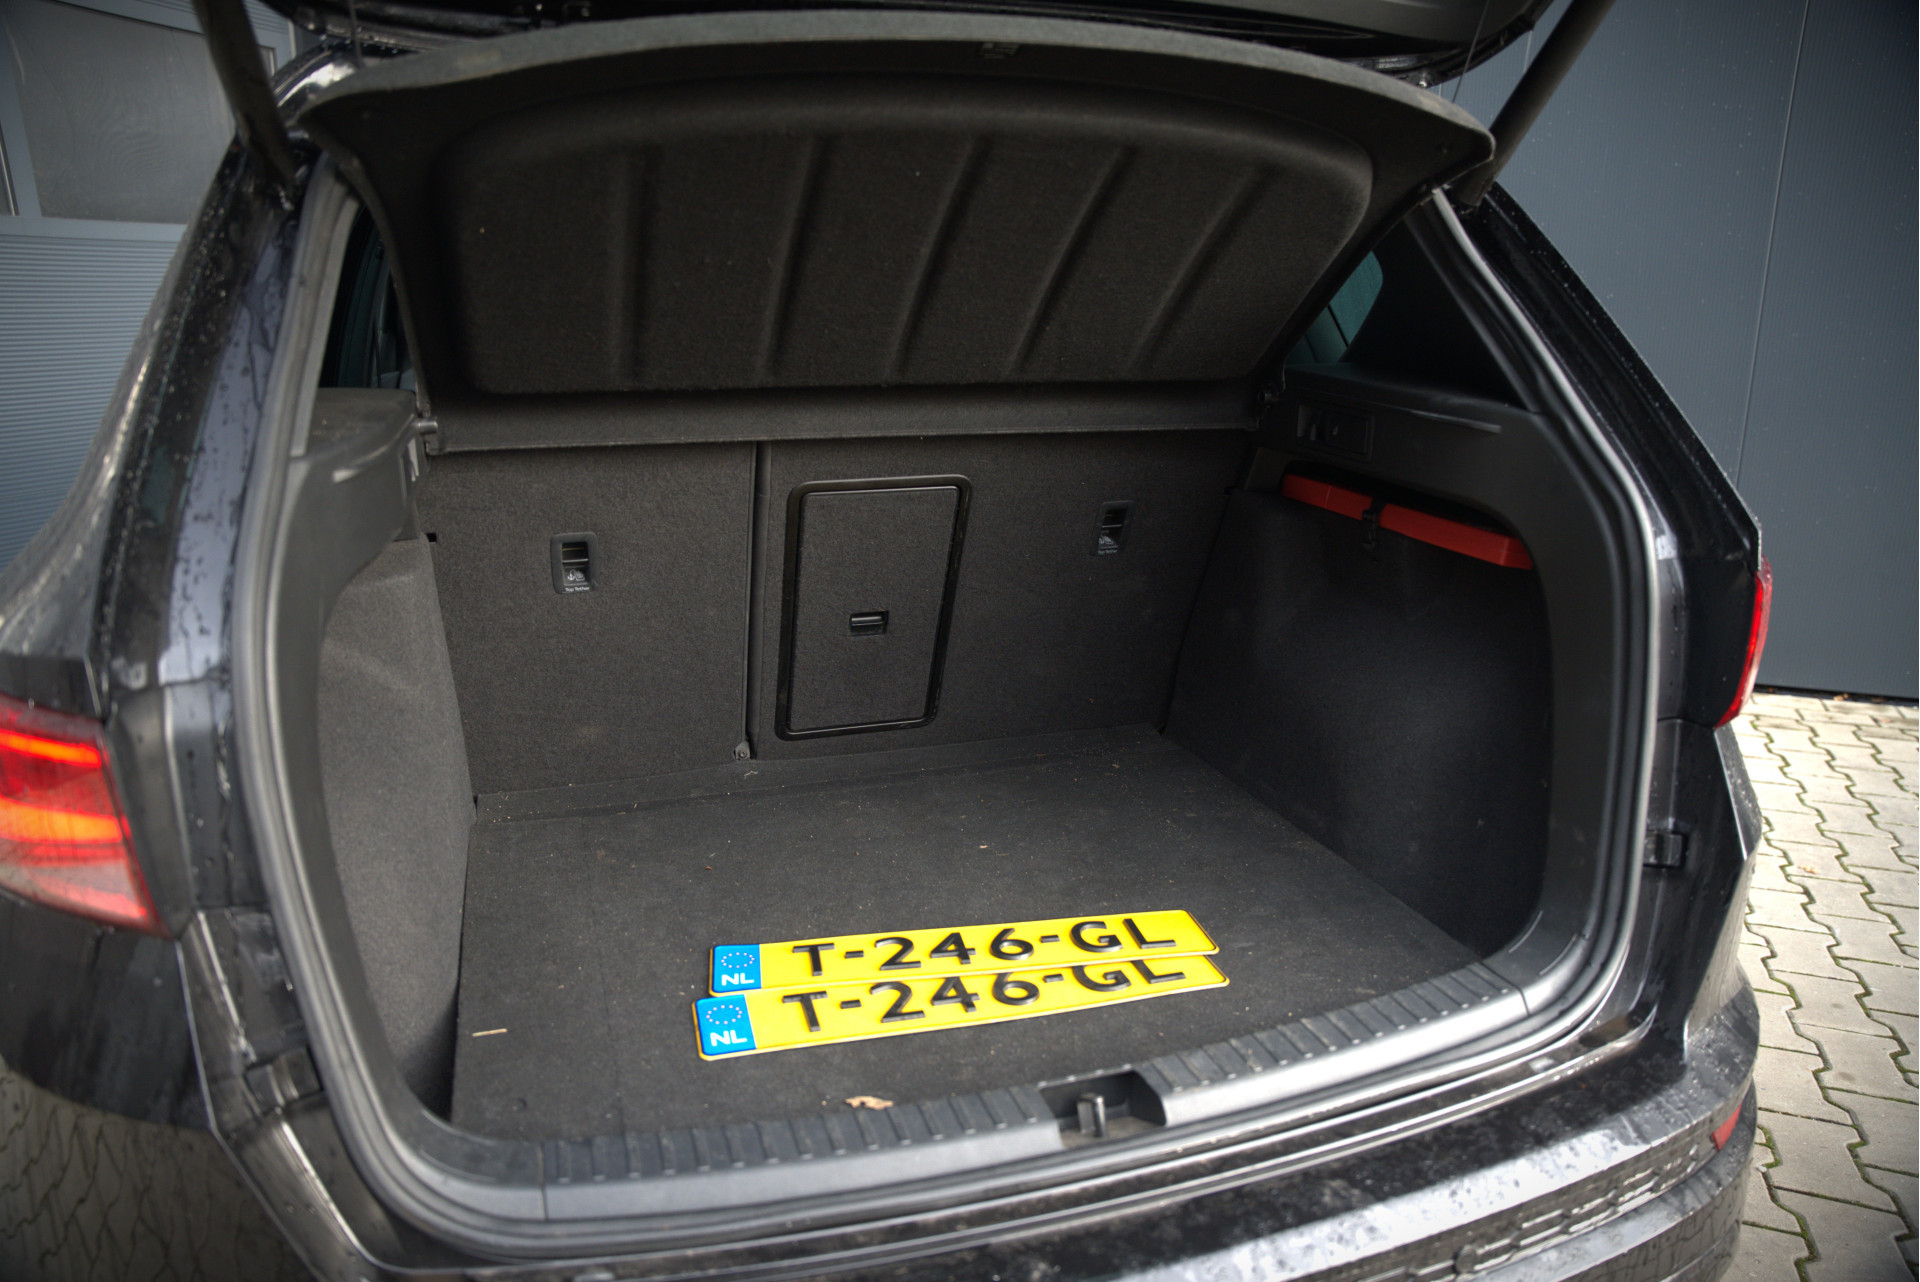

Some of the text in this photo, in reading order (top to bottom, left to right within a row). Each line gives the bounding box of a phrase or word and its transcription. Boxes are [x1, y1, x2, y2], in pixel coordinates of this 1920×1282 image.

[721, 918, 1177, 986] NL T-246-GL
[710, 960, 1187, 1046] NL T-246-GL
